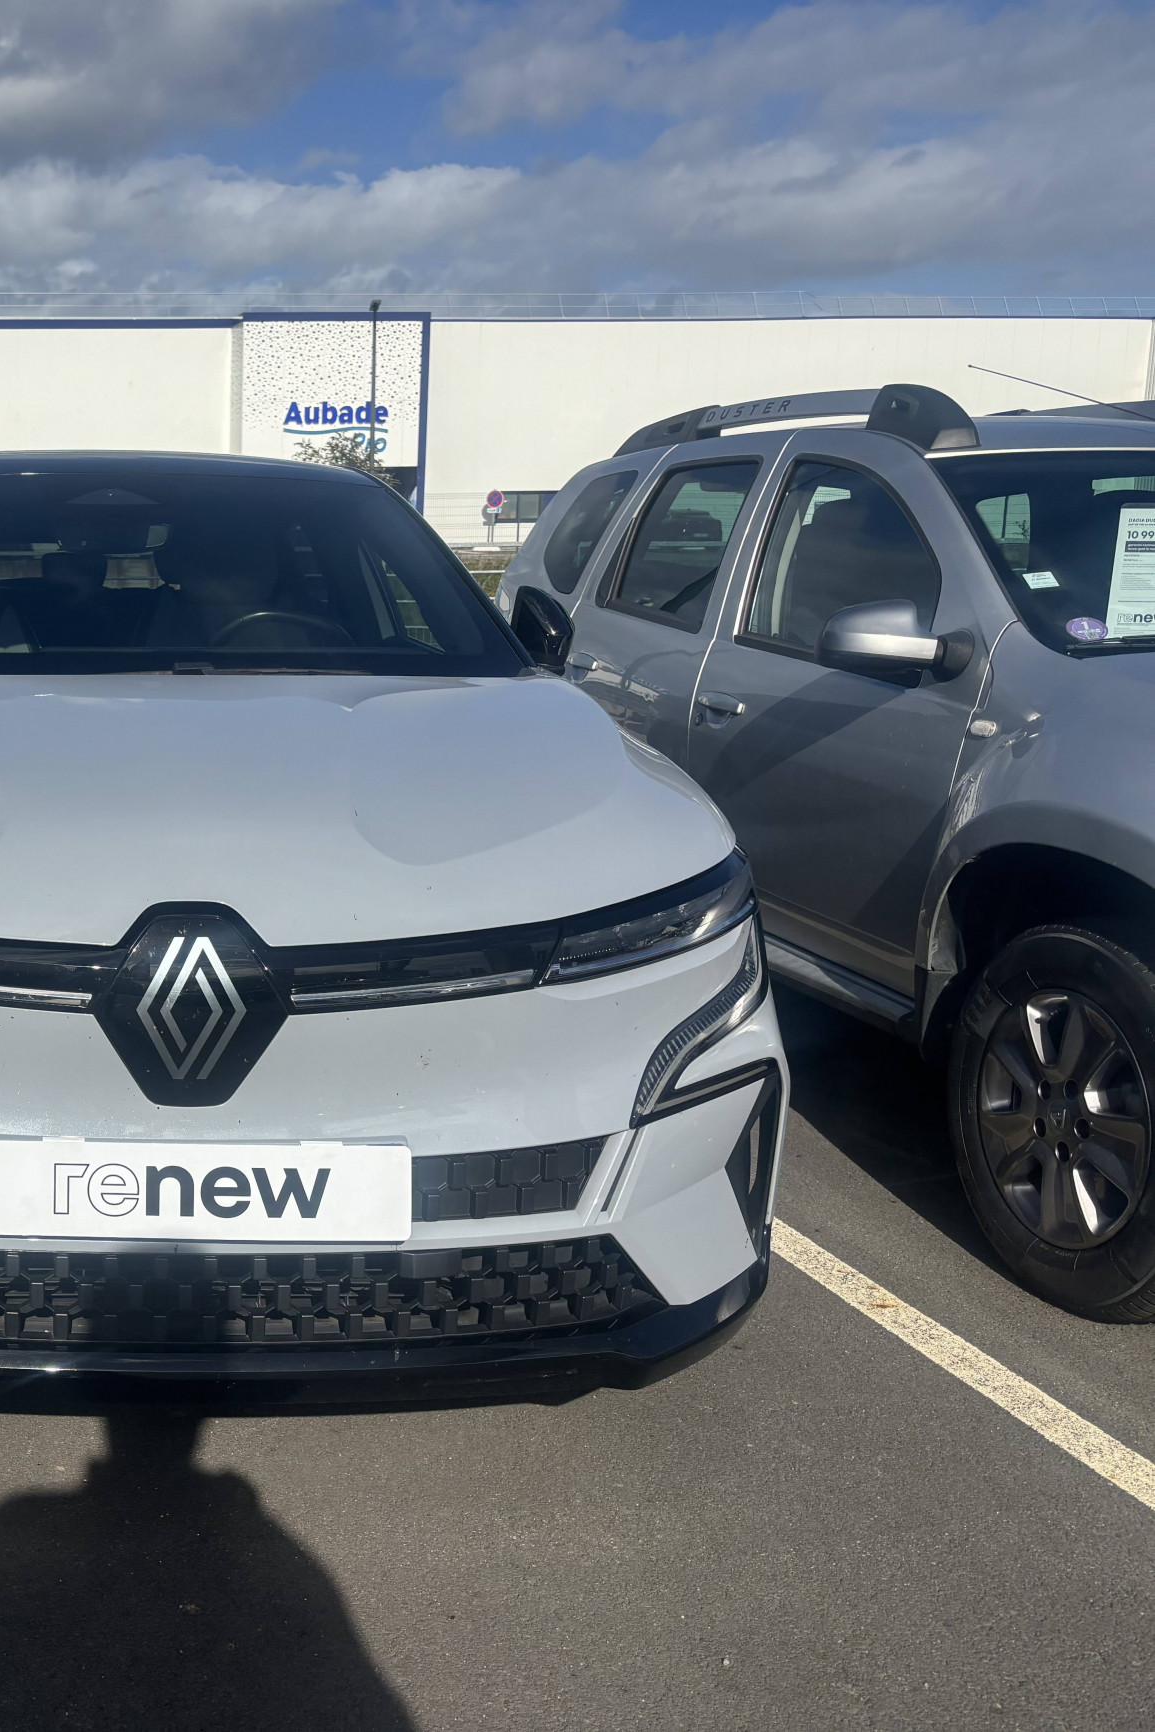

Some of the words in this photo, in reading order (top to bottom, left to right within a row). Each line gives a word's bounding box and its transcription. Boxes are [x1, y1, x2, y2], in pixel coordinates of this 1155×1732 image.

[282, 400, 389, 426] Aubade
[706, 399, 792, 423] DUSTER
[1127, 530, 1139, 539] 10
[1141, 530, 1155, 540] 99
[1117, 613, 1155, 623] rene
[52, 1162, 332, 1219] renew
